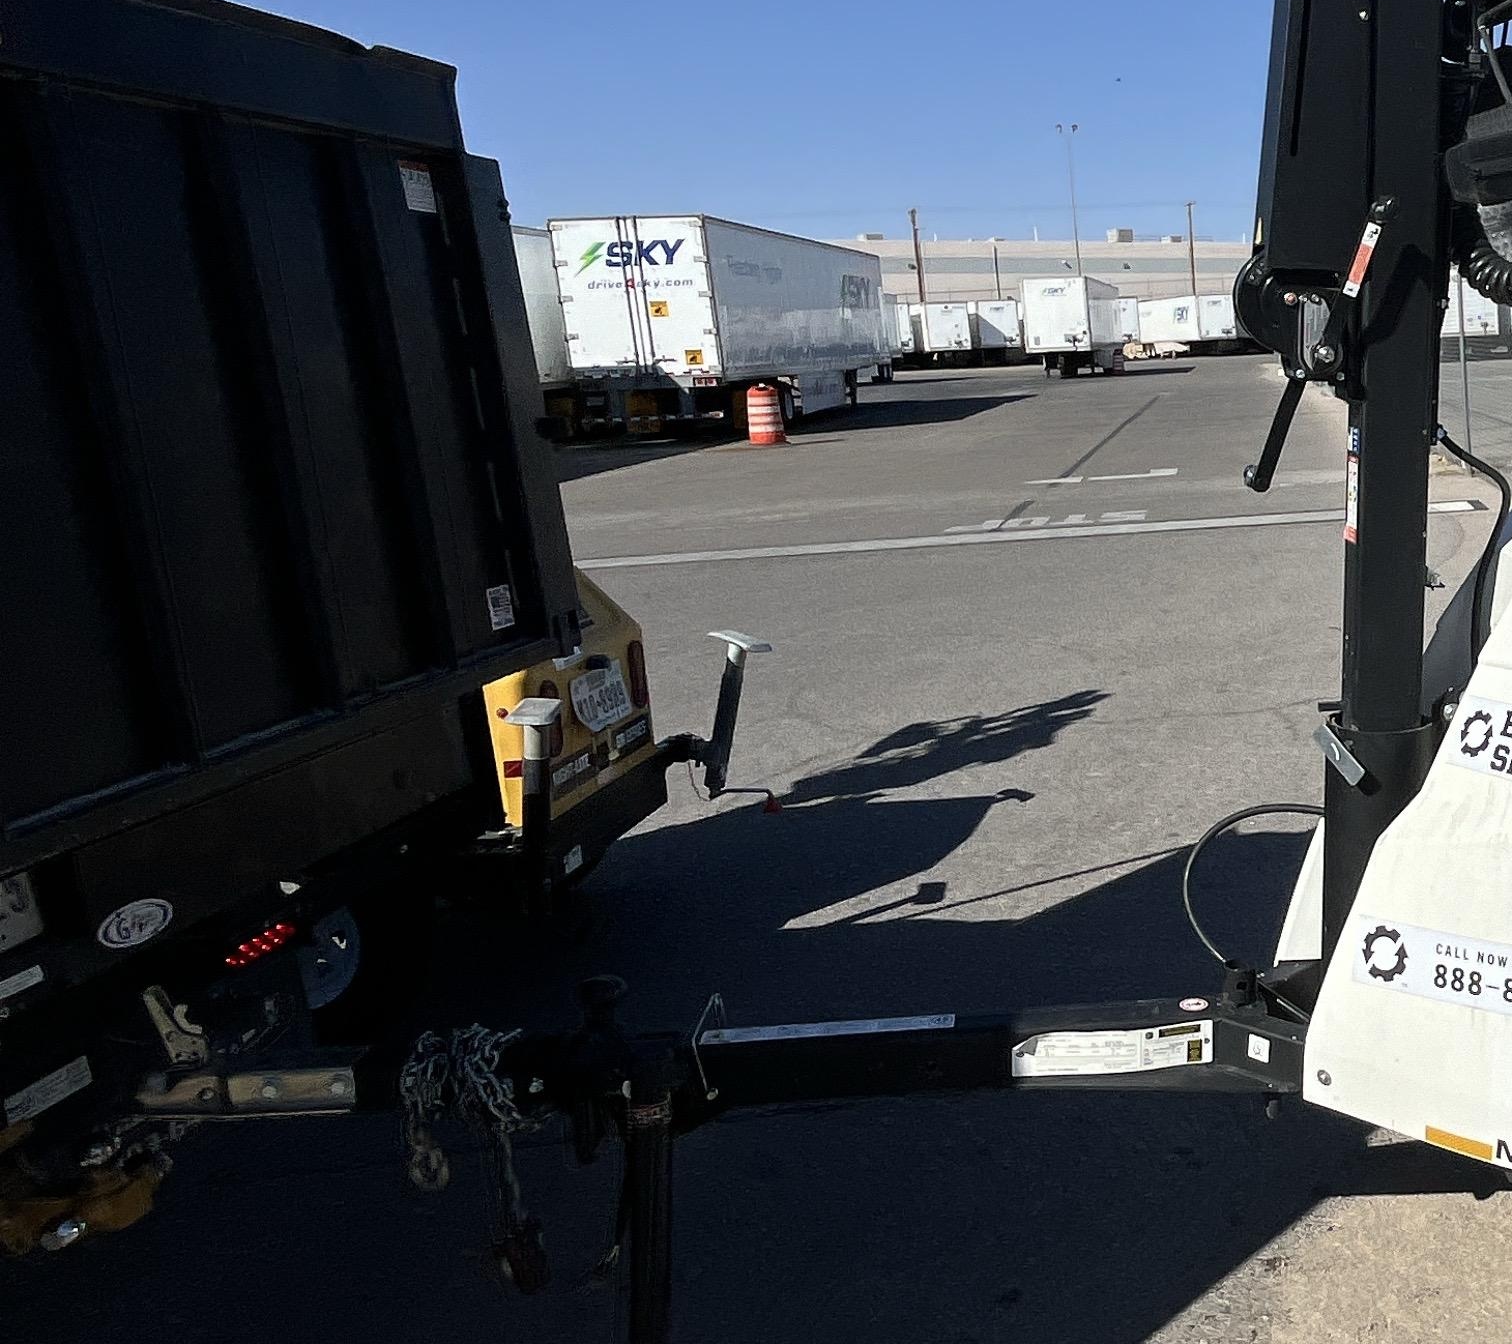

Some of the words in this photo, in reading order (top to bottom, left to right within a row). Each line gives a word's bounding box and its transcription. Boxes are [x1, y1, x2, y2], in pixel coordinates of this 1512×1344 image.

[606, 238, 686, 267] SKY
[1435, 943, 1470, 961] CALL
[1476, 951, 1508, 968] NOW
